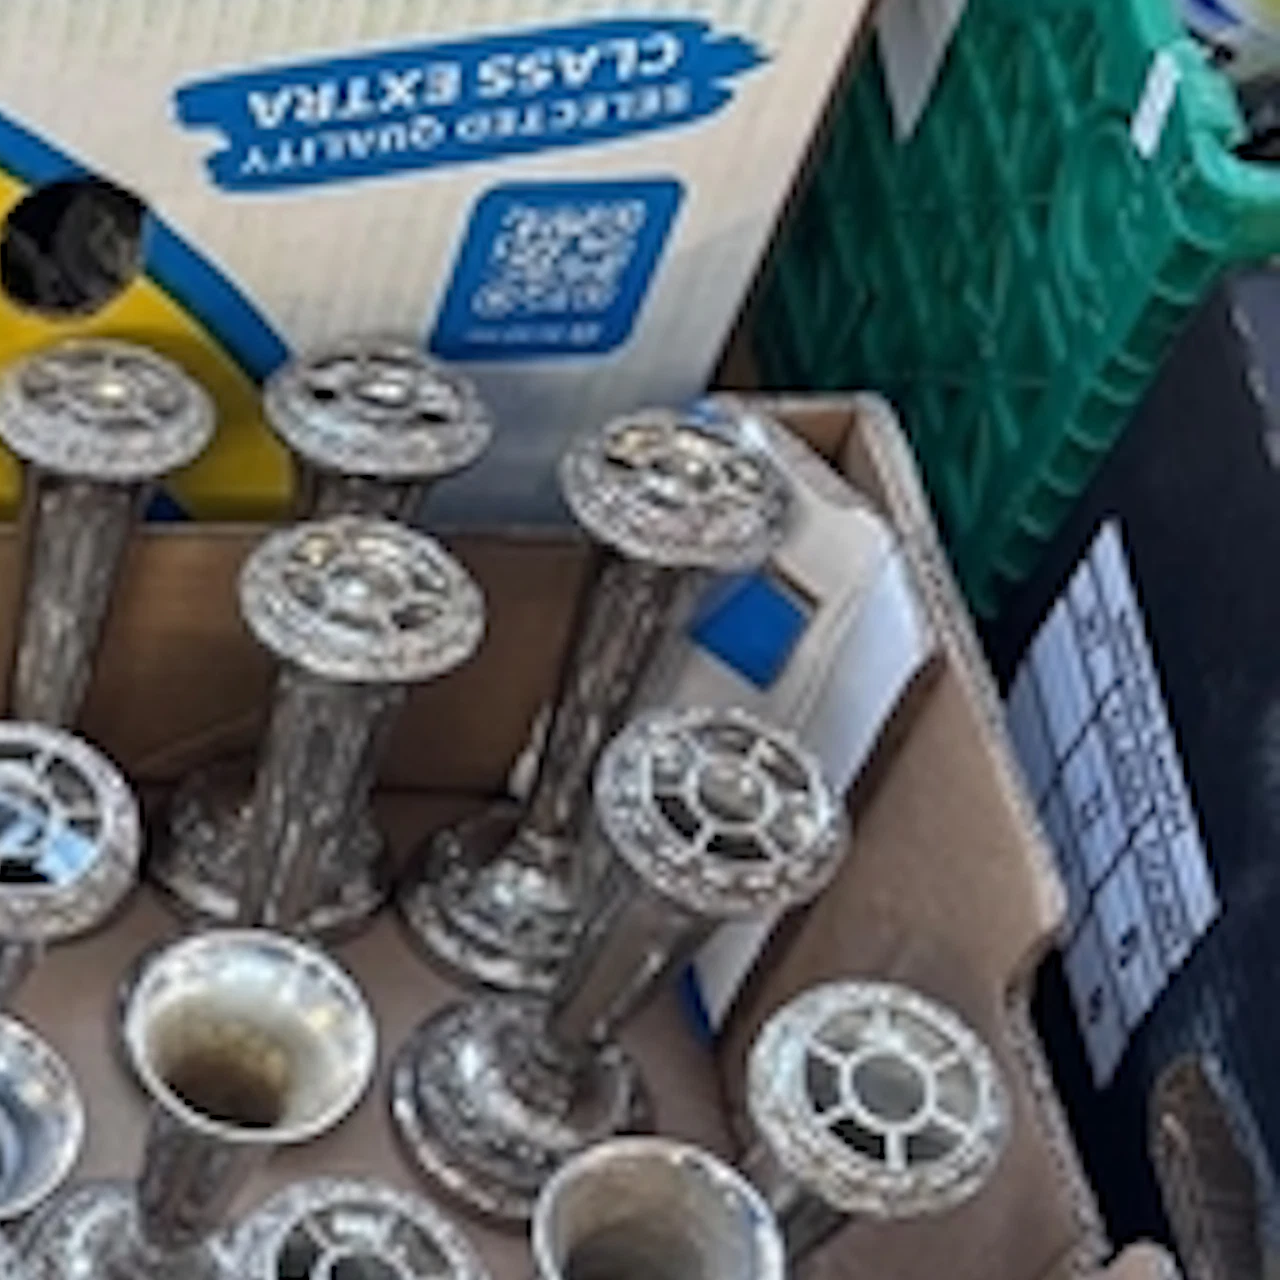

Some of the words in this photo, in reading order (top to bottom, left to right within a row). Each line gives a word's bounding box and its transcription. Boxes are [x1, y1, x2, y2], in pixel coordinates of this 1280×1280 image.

[247, 60, 461, 129] EXTRA
[477, 30, 683, 98] CLASS
[456, 80, 692, 142] SELECTED
[241, 115, 444, 175] QUALITY
